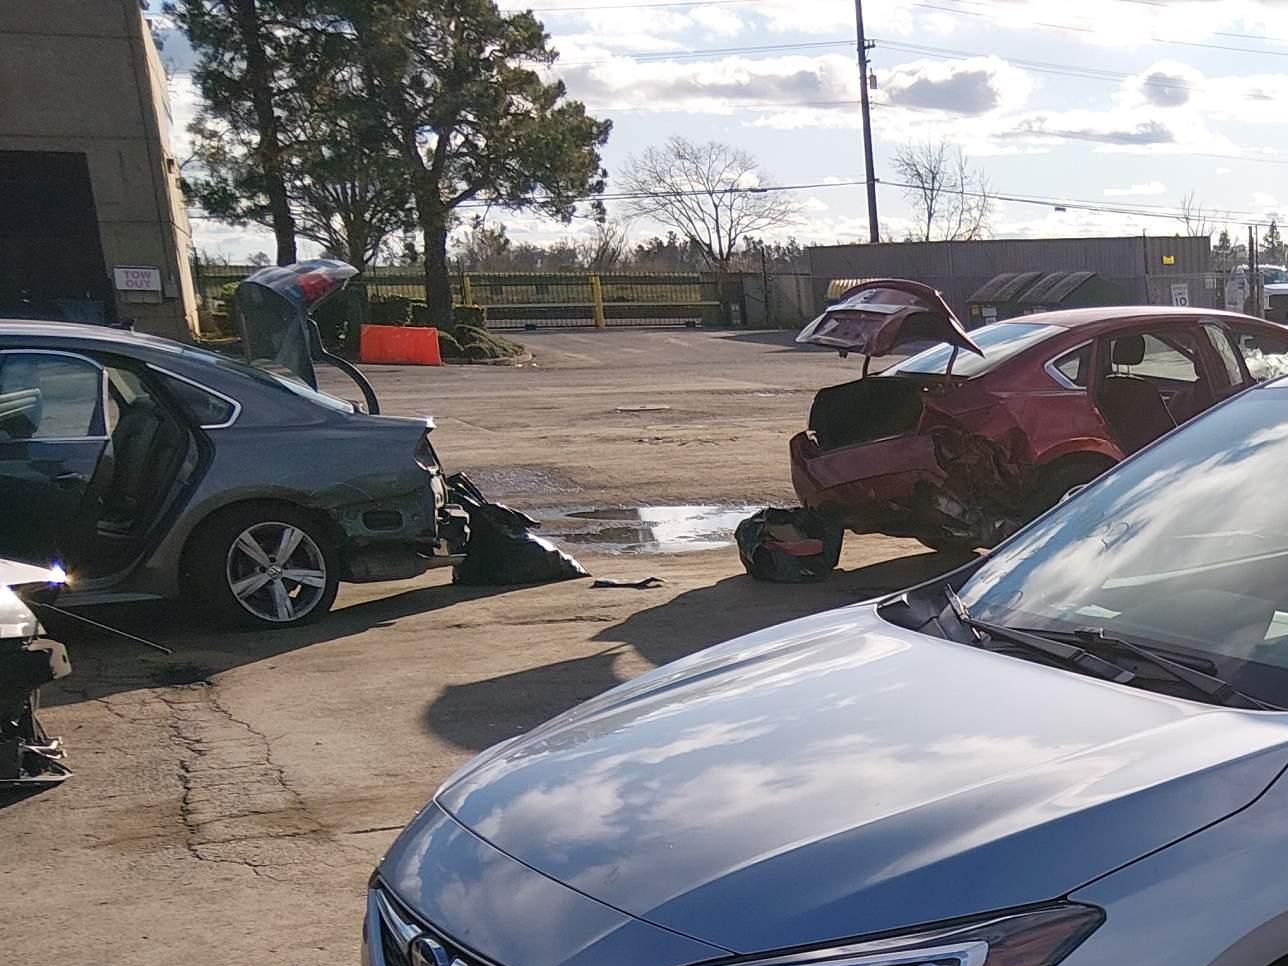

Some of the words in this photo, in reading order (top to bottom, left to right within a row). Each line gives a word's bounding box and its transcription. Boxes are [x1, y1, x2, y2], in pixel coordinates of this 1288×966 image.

[125, 271, 151, 279] TOW
[126, 280, 151, 288] OUT
[1175, 297, 1187, 306] 10
